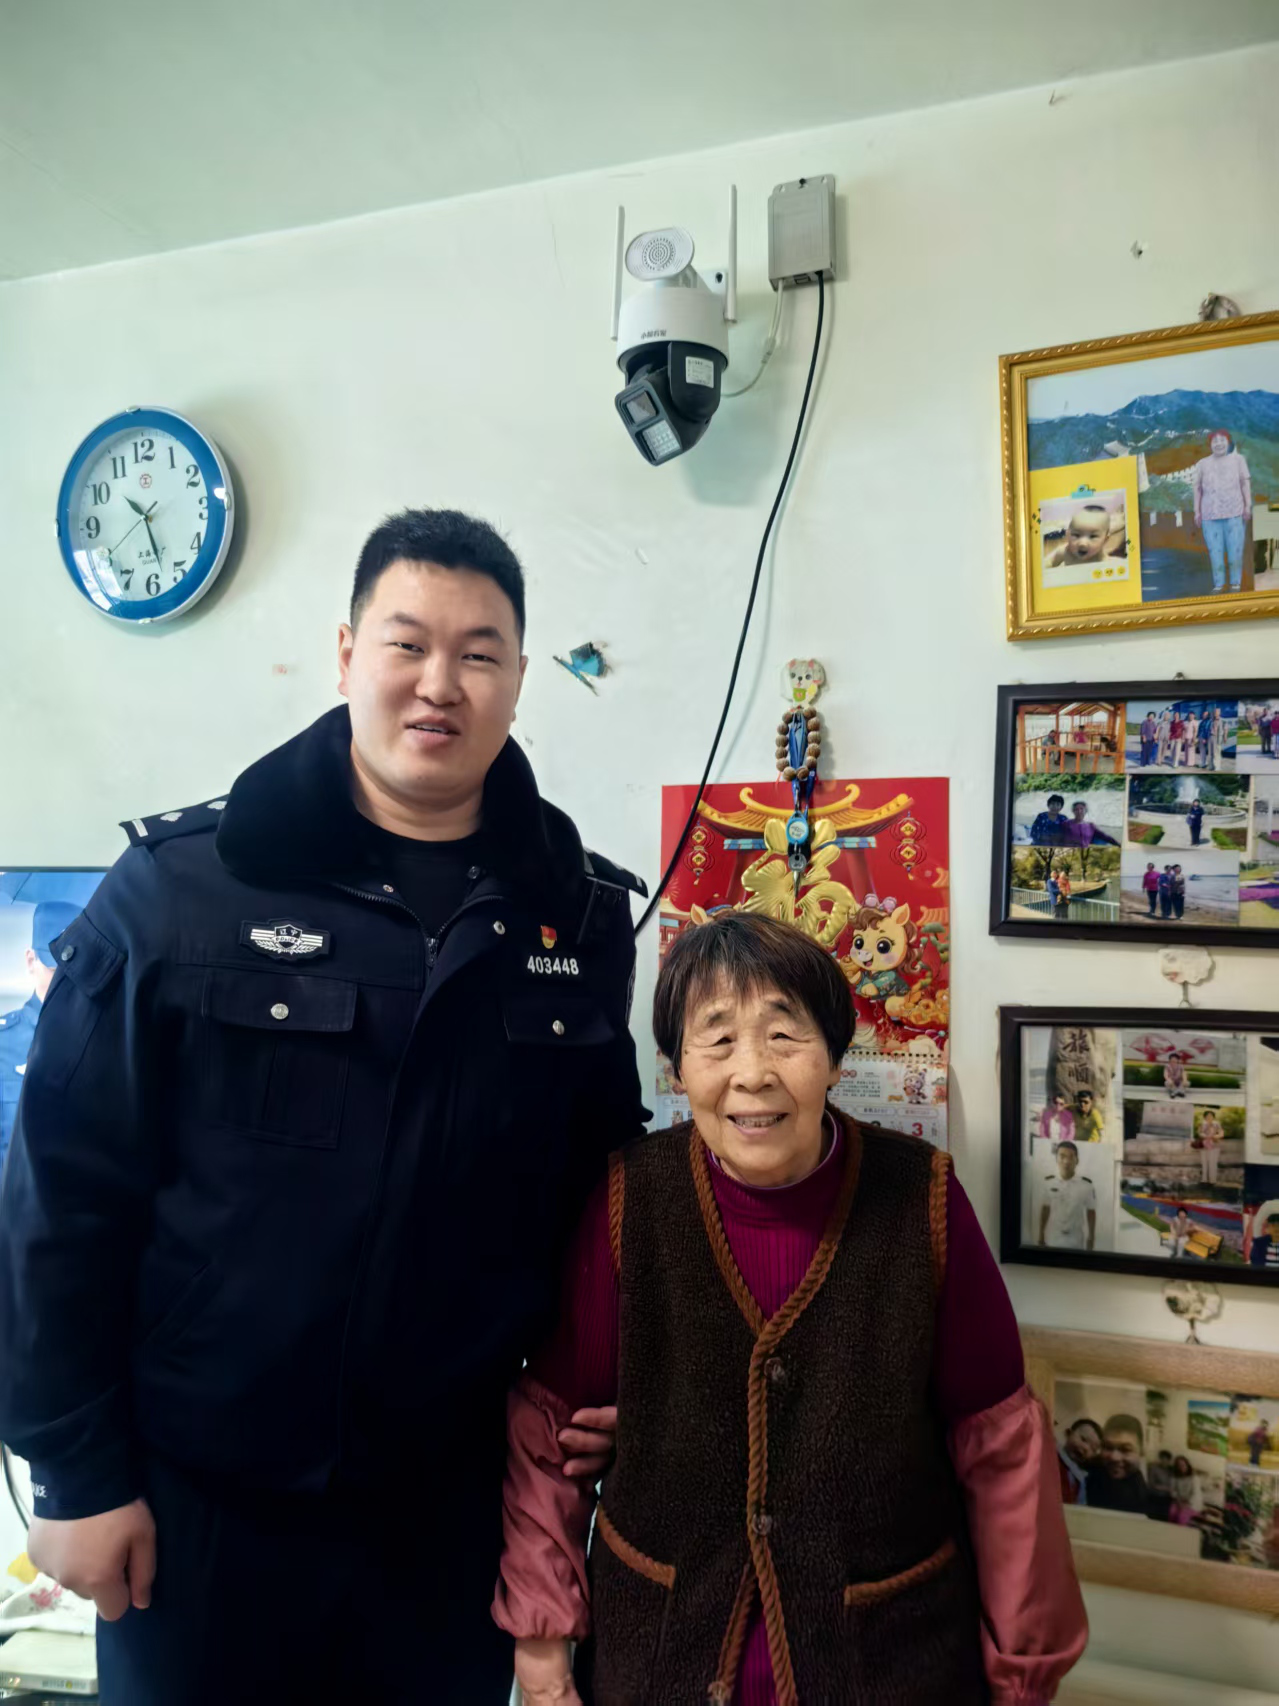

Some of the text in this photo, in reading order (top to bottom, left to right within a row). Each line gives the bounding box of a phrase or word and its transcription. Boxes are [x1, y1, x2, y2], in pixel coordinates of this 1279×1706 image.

[132, 438, 156, 464] 12
[168, 446, 177, 469] 1
[111, 456, 127, 480] 11
[185, 464, 201, 489] 2
[91, 481, 111, 506] 10
[86, 516, 101, 539] 9
[190, 531, 202, 555] 4
[120, 567, 135, 591] 7
[172, 560, 187, 584] 5
[145, 573, 161, 596] 6
[526, 955, 580, 976] 403448
[911, 1121, 924, 1138] 3
